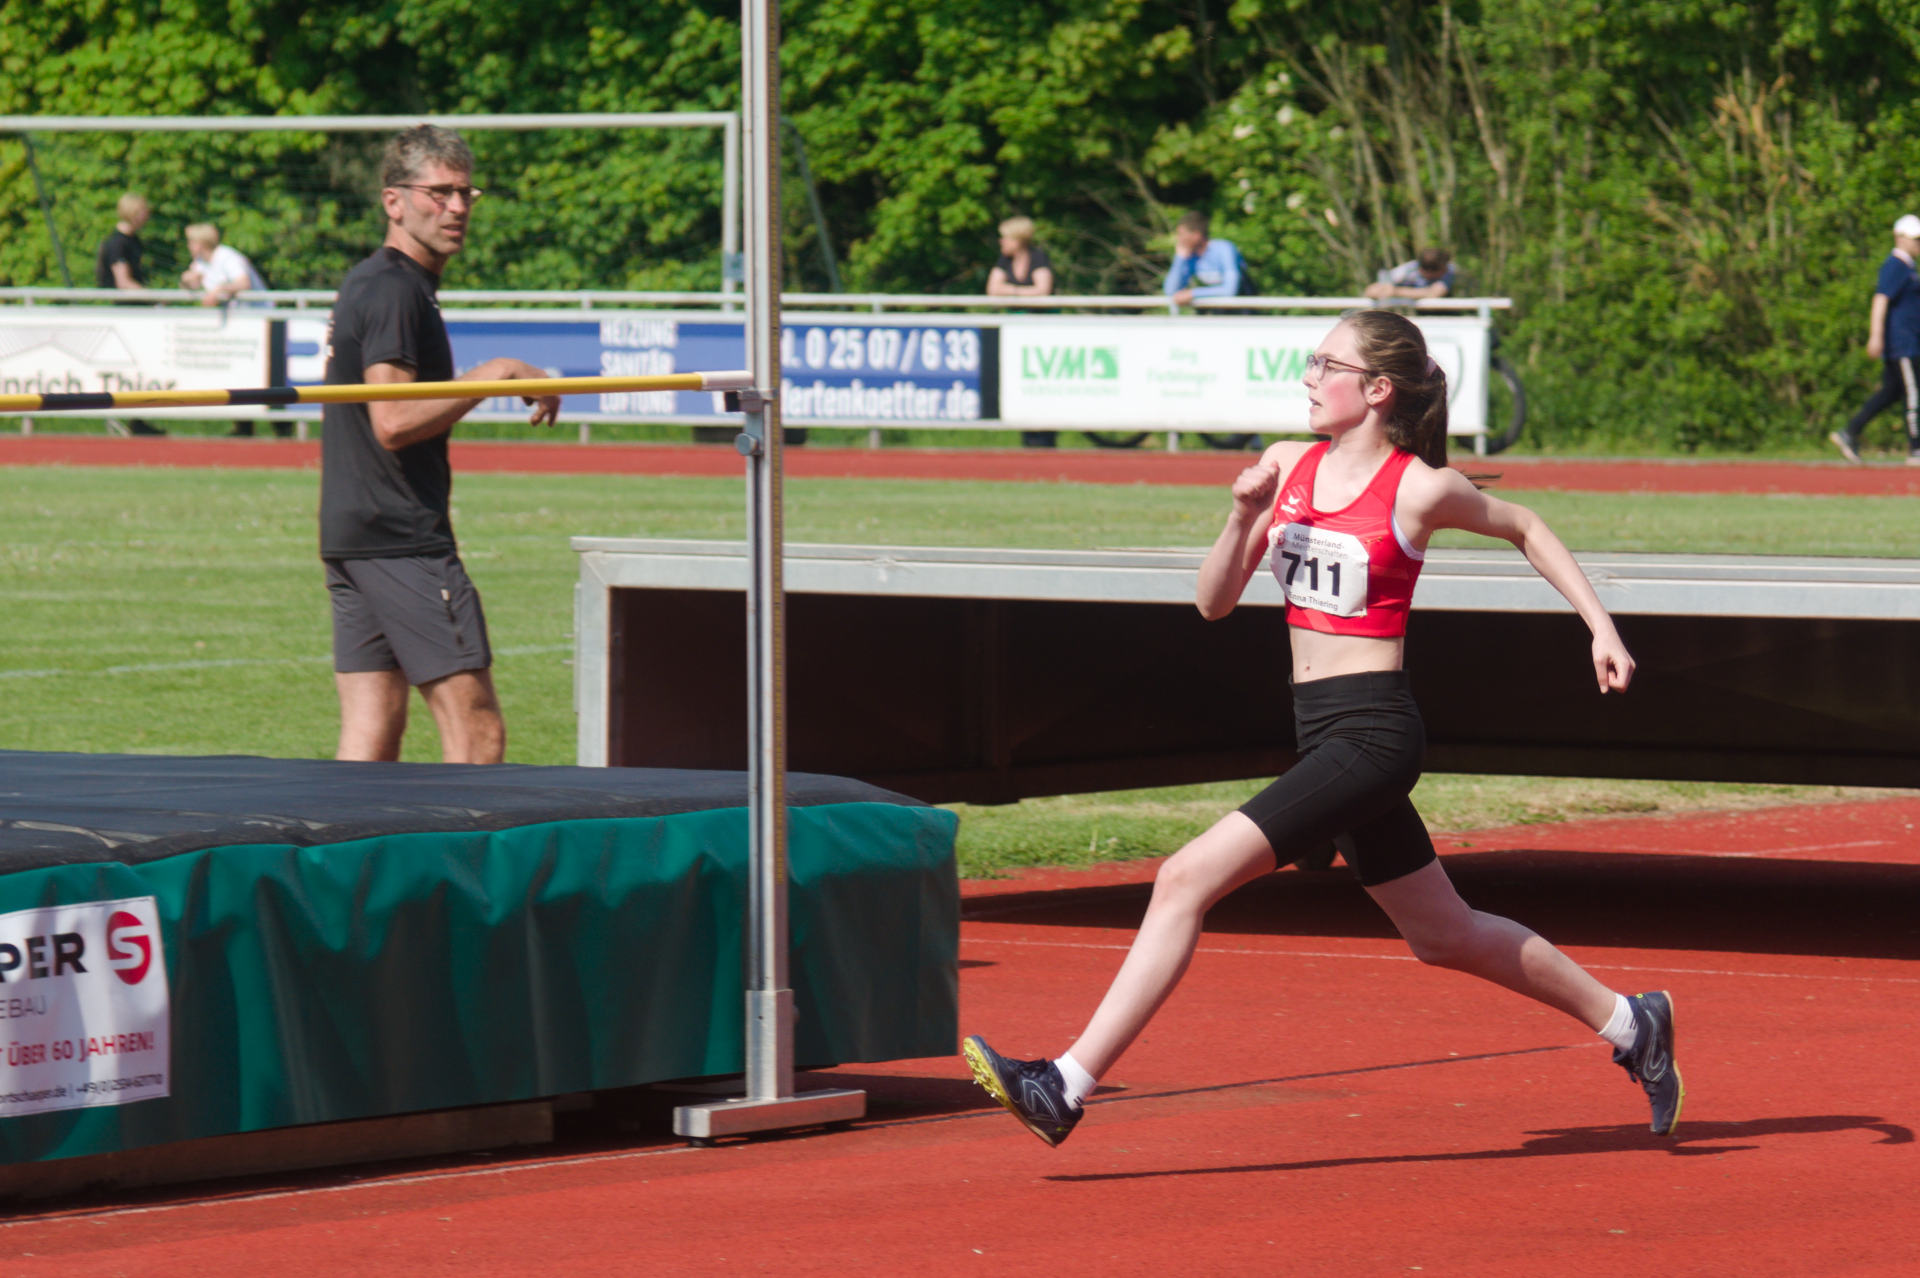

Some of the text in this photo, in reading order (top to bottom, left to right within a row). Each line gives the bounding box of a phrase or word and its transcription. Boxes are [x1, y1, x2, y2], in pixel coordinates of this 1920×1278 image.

[600, 321, 677, 348] HEIZUNG
[806, 327, 827, 369] 0
[1020, 346, 1086, 379] LVM
[1281, 550, 1341, 598] 711
[8, 1041, 47, 1067] ÜBER
[52, 1040, 73, 1061] 60
[79, 1031, 155, 1062] JAHREN!
